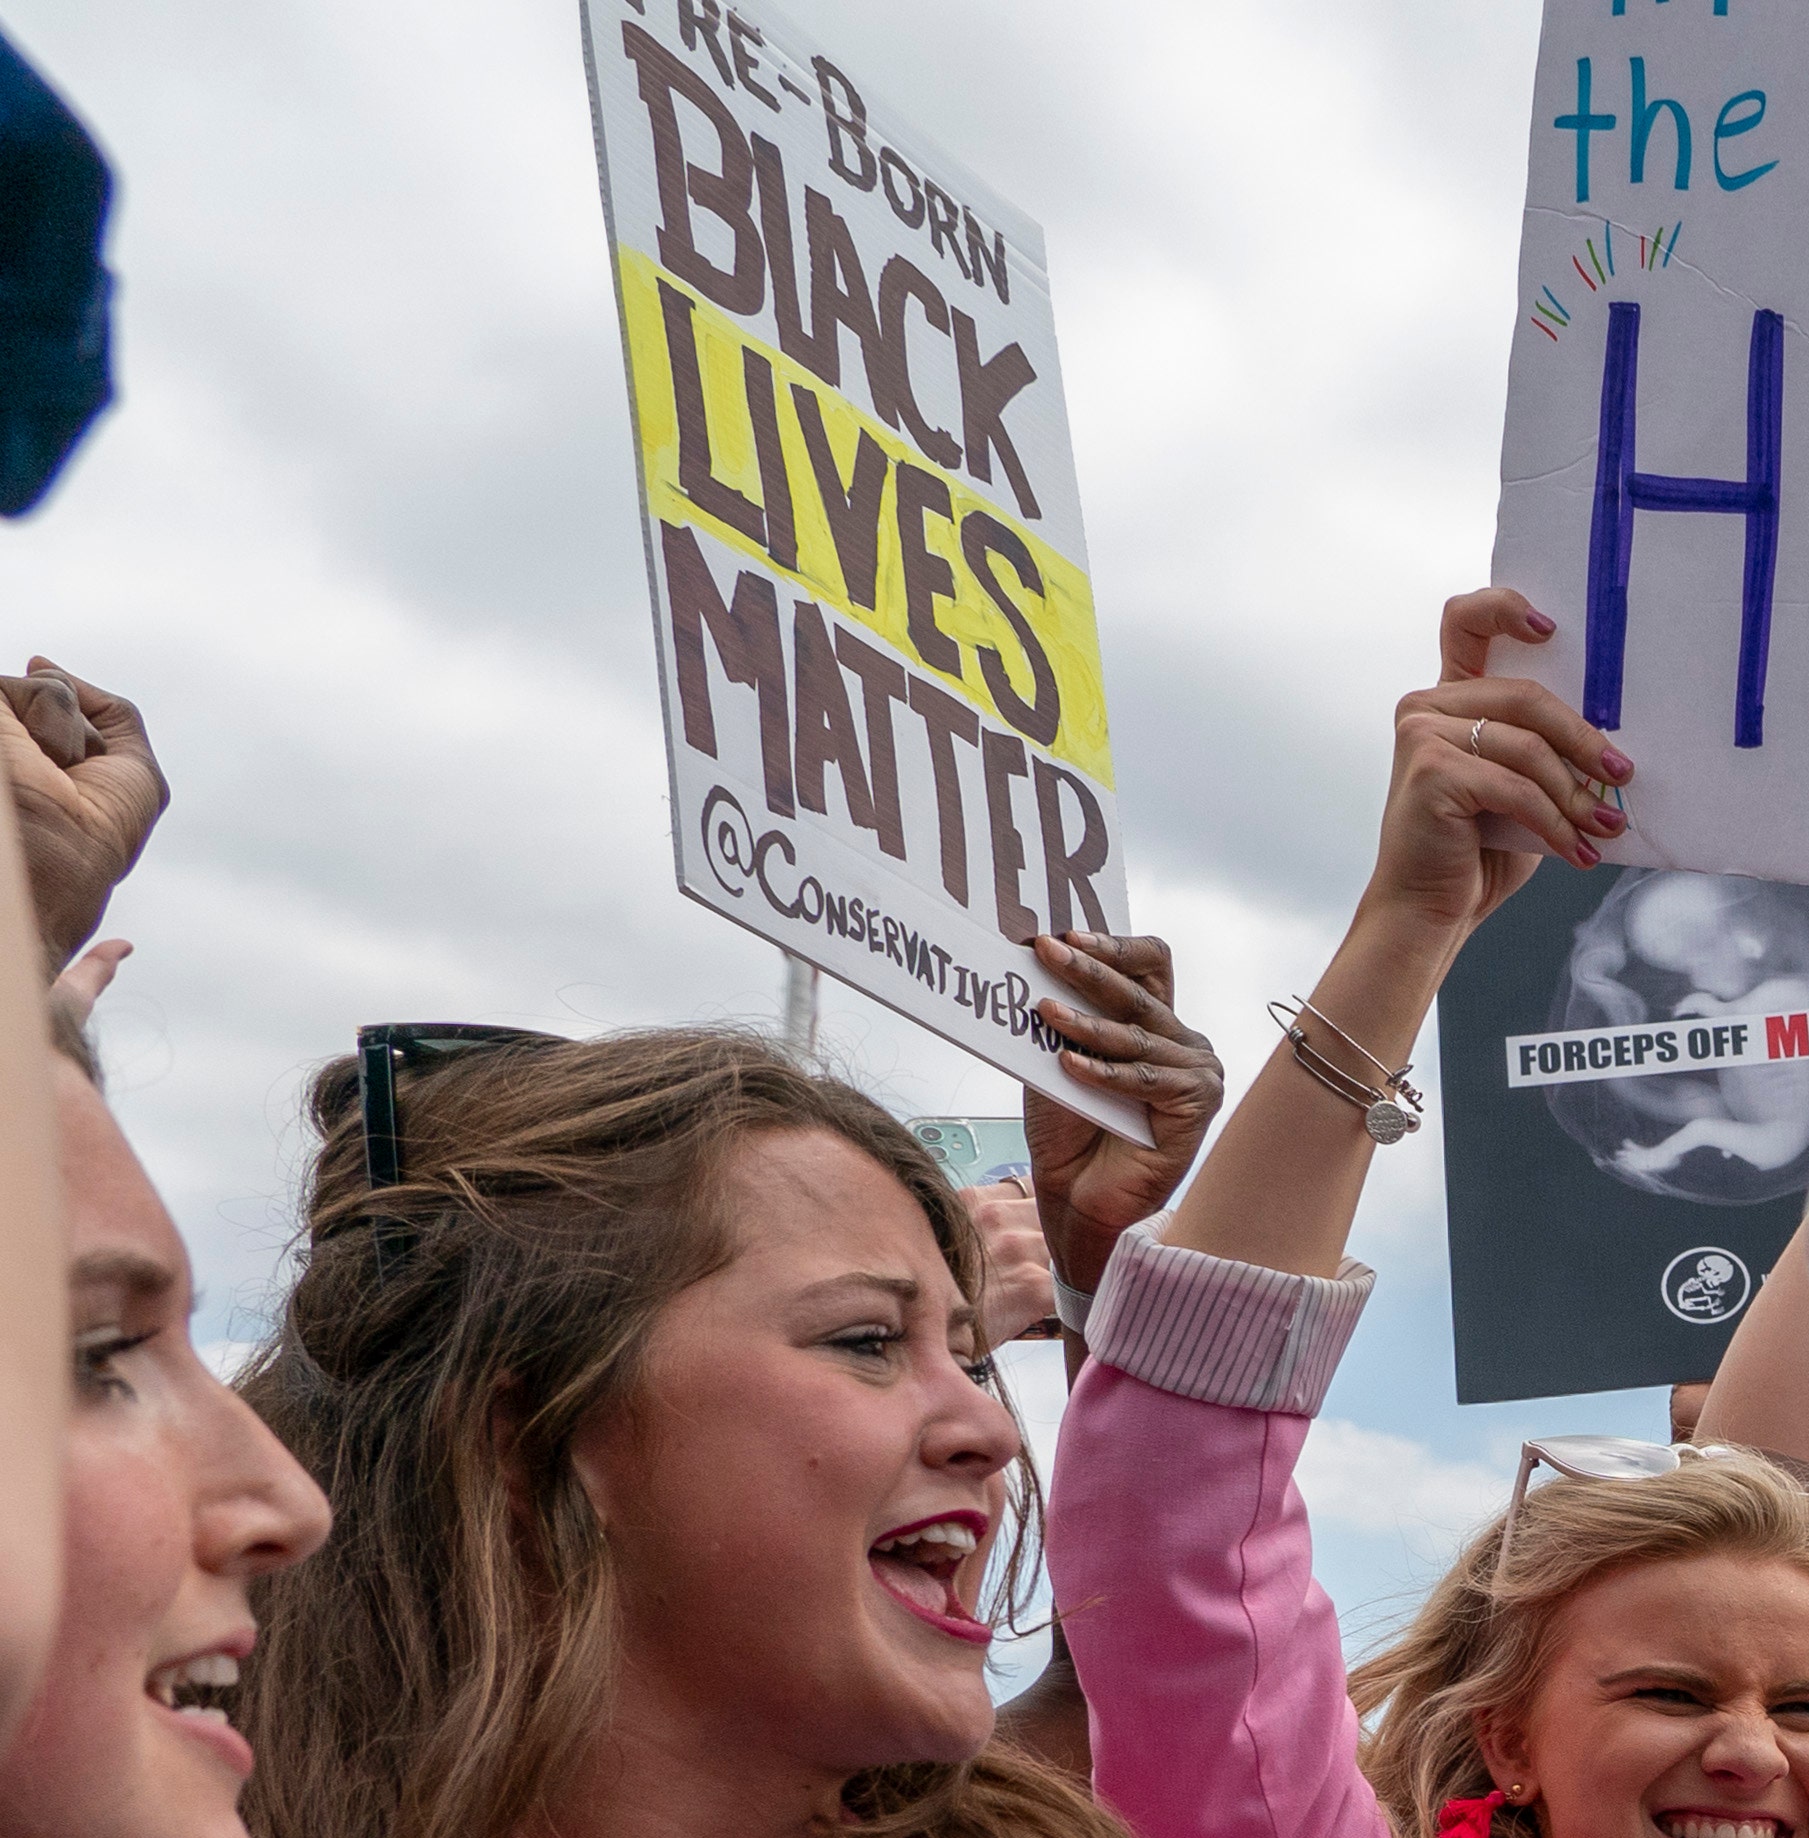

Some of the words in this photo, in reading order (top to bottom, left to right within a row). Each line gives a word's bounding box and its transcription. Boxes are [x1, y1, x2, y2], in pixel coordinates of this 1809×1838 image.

[620, 0, 1010, 305] RE-BORN
[621, 20, 1042, 520] BLACK
[1554, 56, 1779, 203] the
[655, 276, 1060, 748] LIVES
[659, 518, 1110, 946] MATTER
[1518, 1030, 1679, 1077] FORCEPS
[1689, 1023, 1749, 1063] OFF
